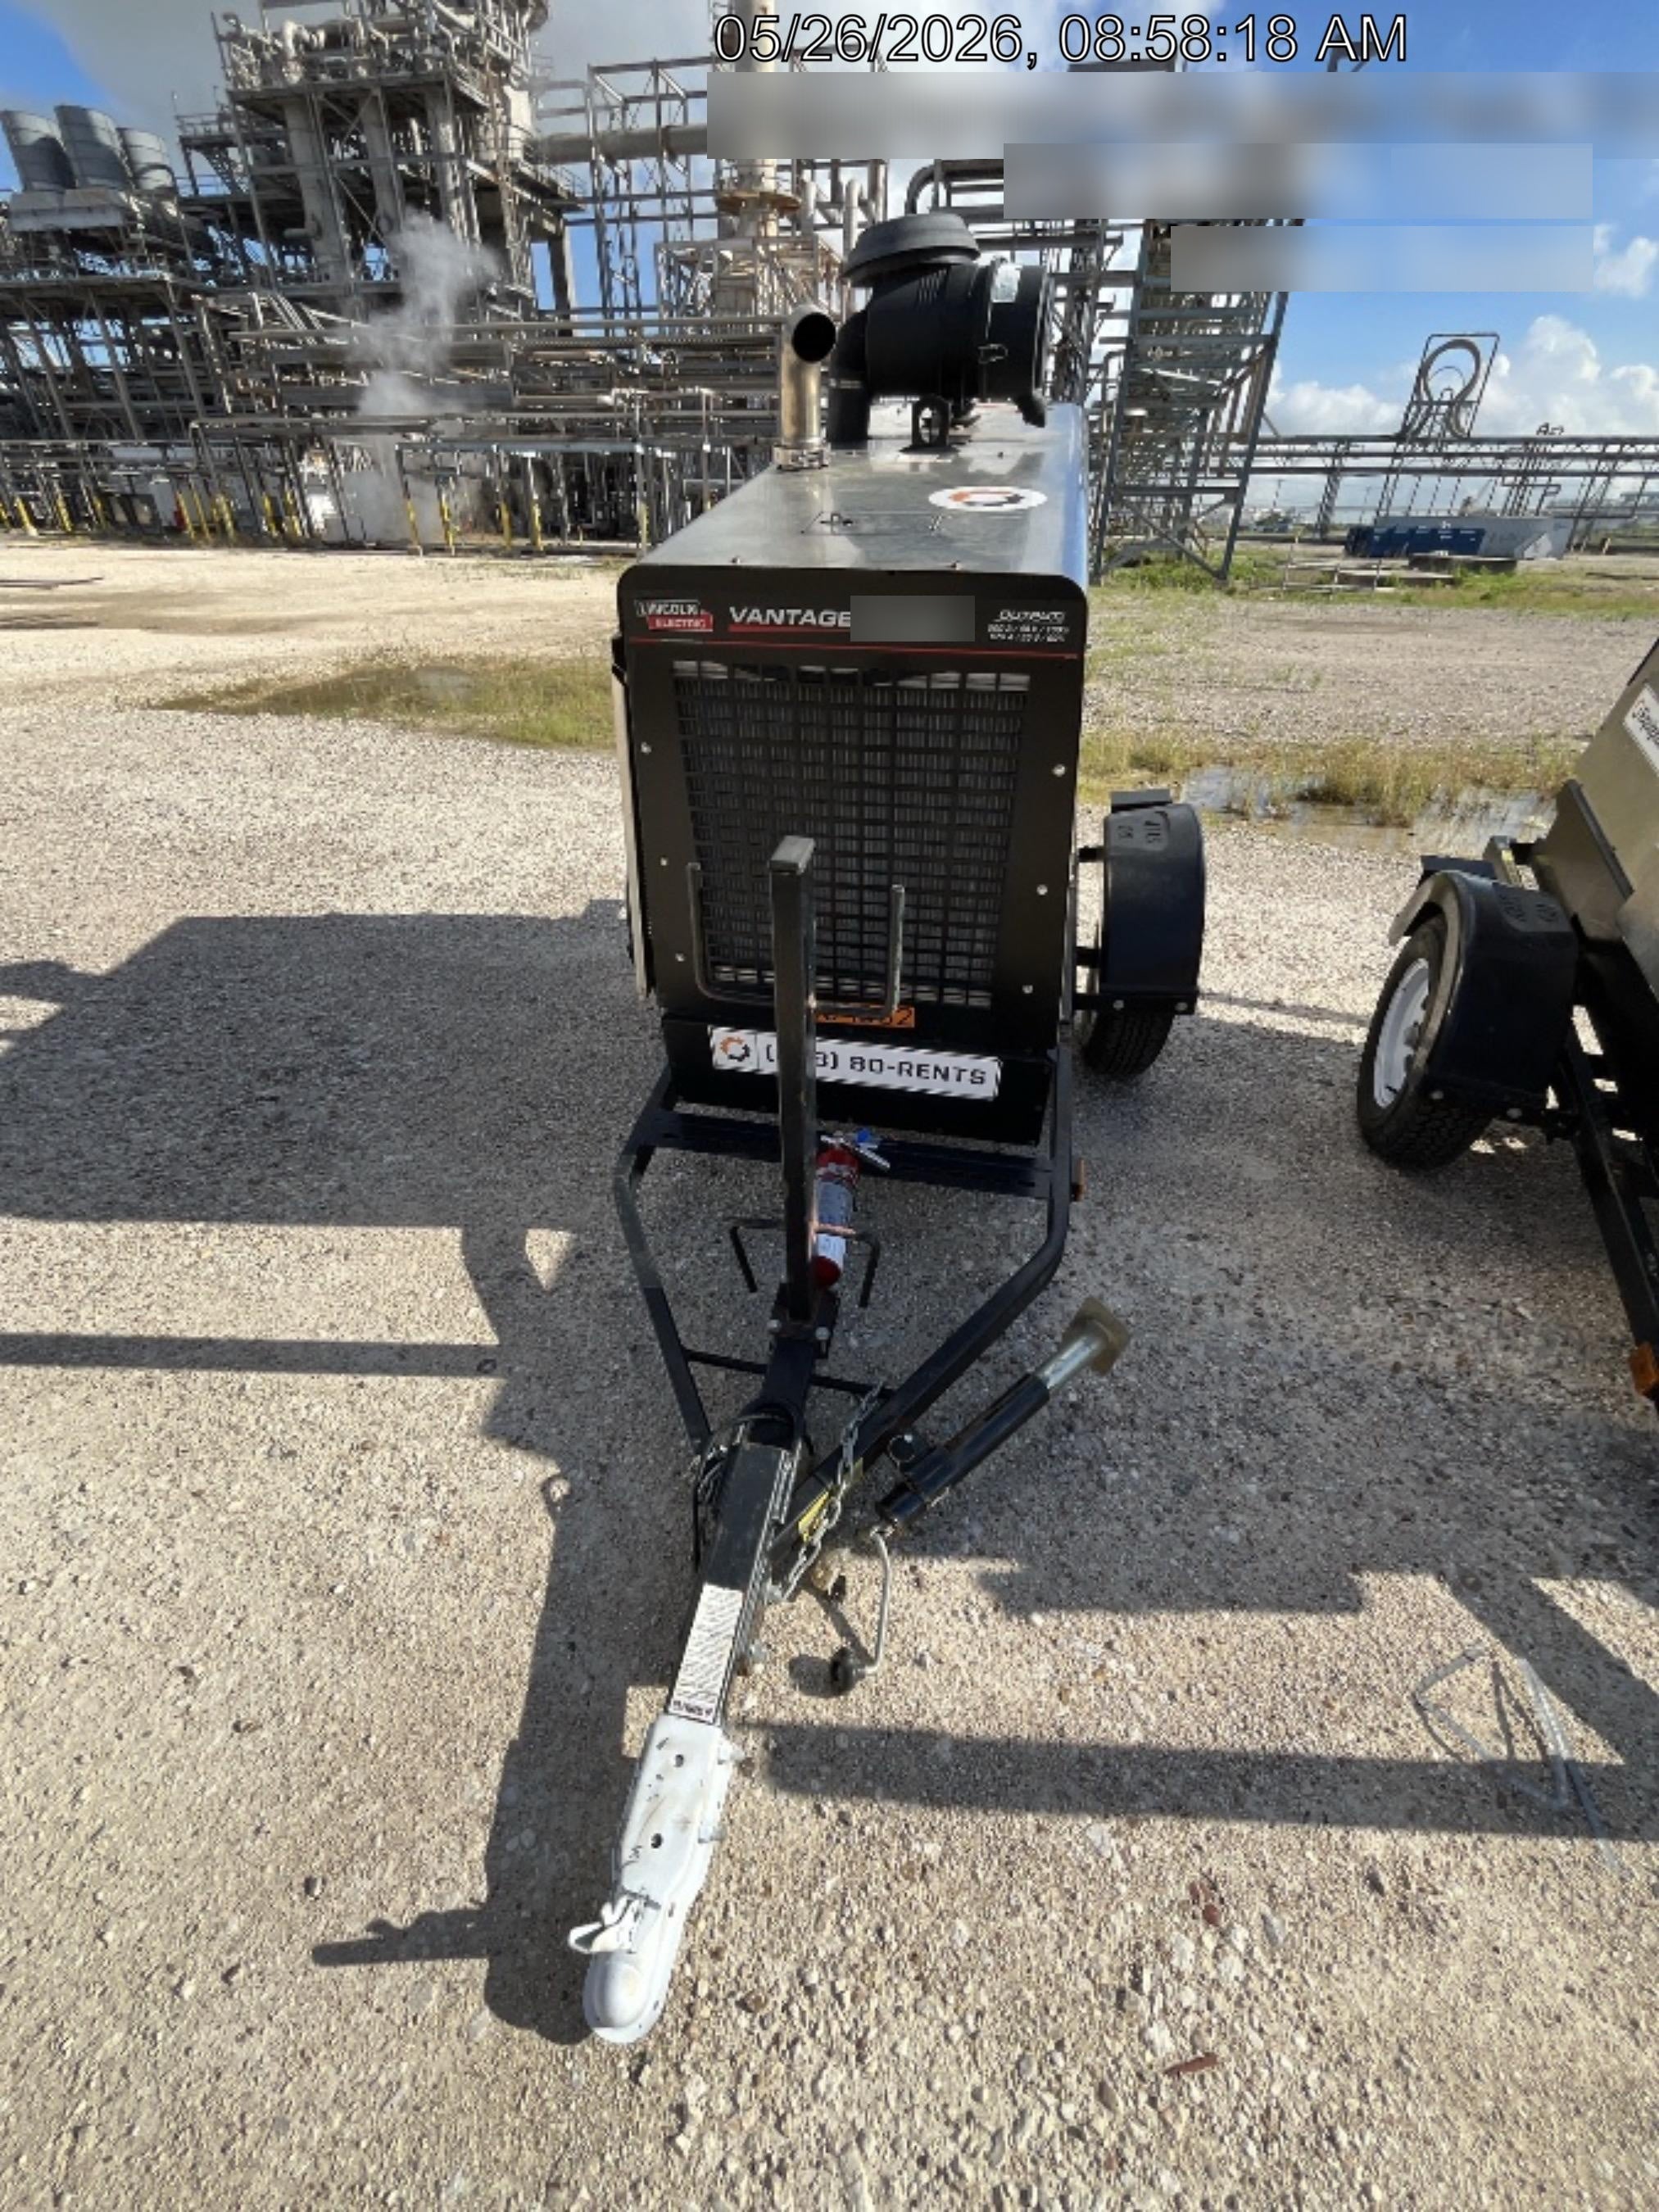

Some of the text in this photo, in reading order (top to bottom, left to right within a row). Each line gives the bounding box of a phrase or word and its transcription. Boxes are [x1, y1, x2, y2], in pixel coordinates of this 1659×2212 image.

[729, 605, 851, 628] VANTAGE
[765, 1044, 986, 1086] (3) 80-RENTS
